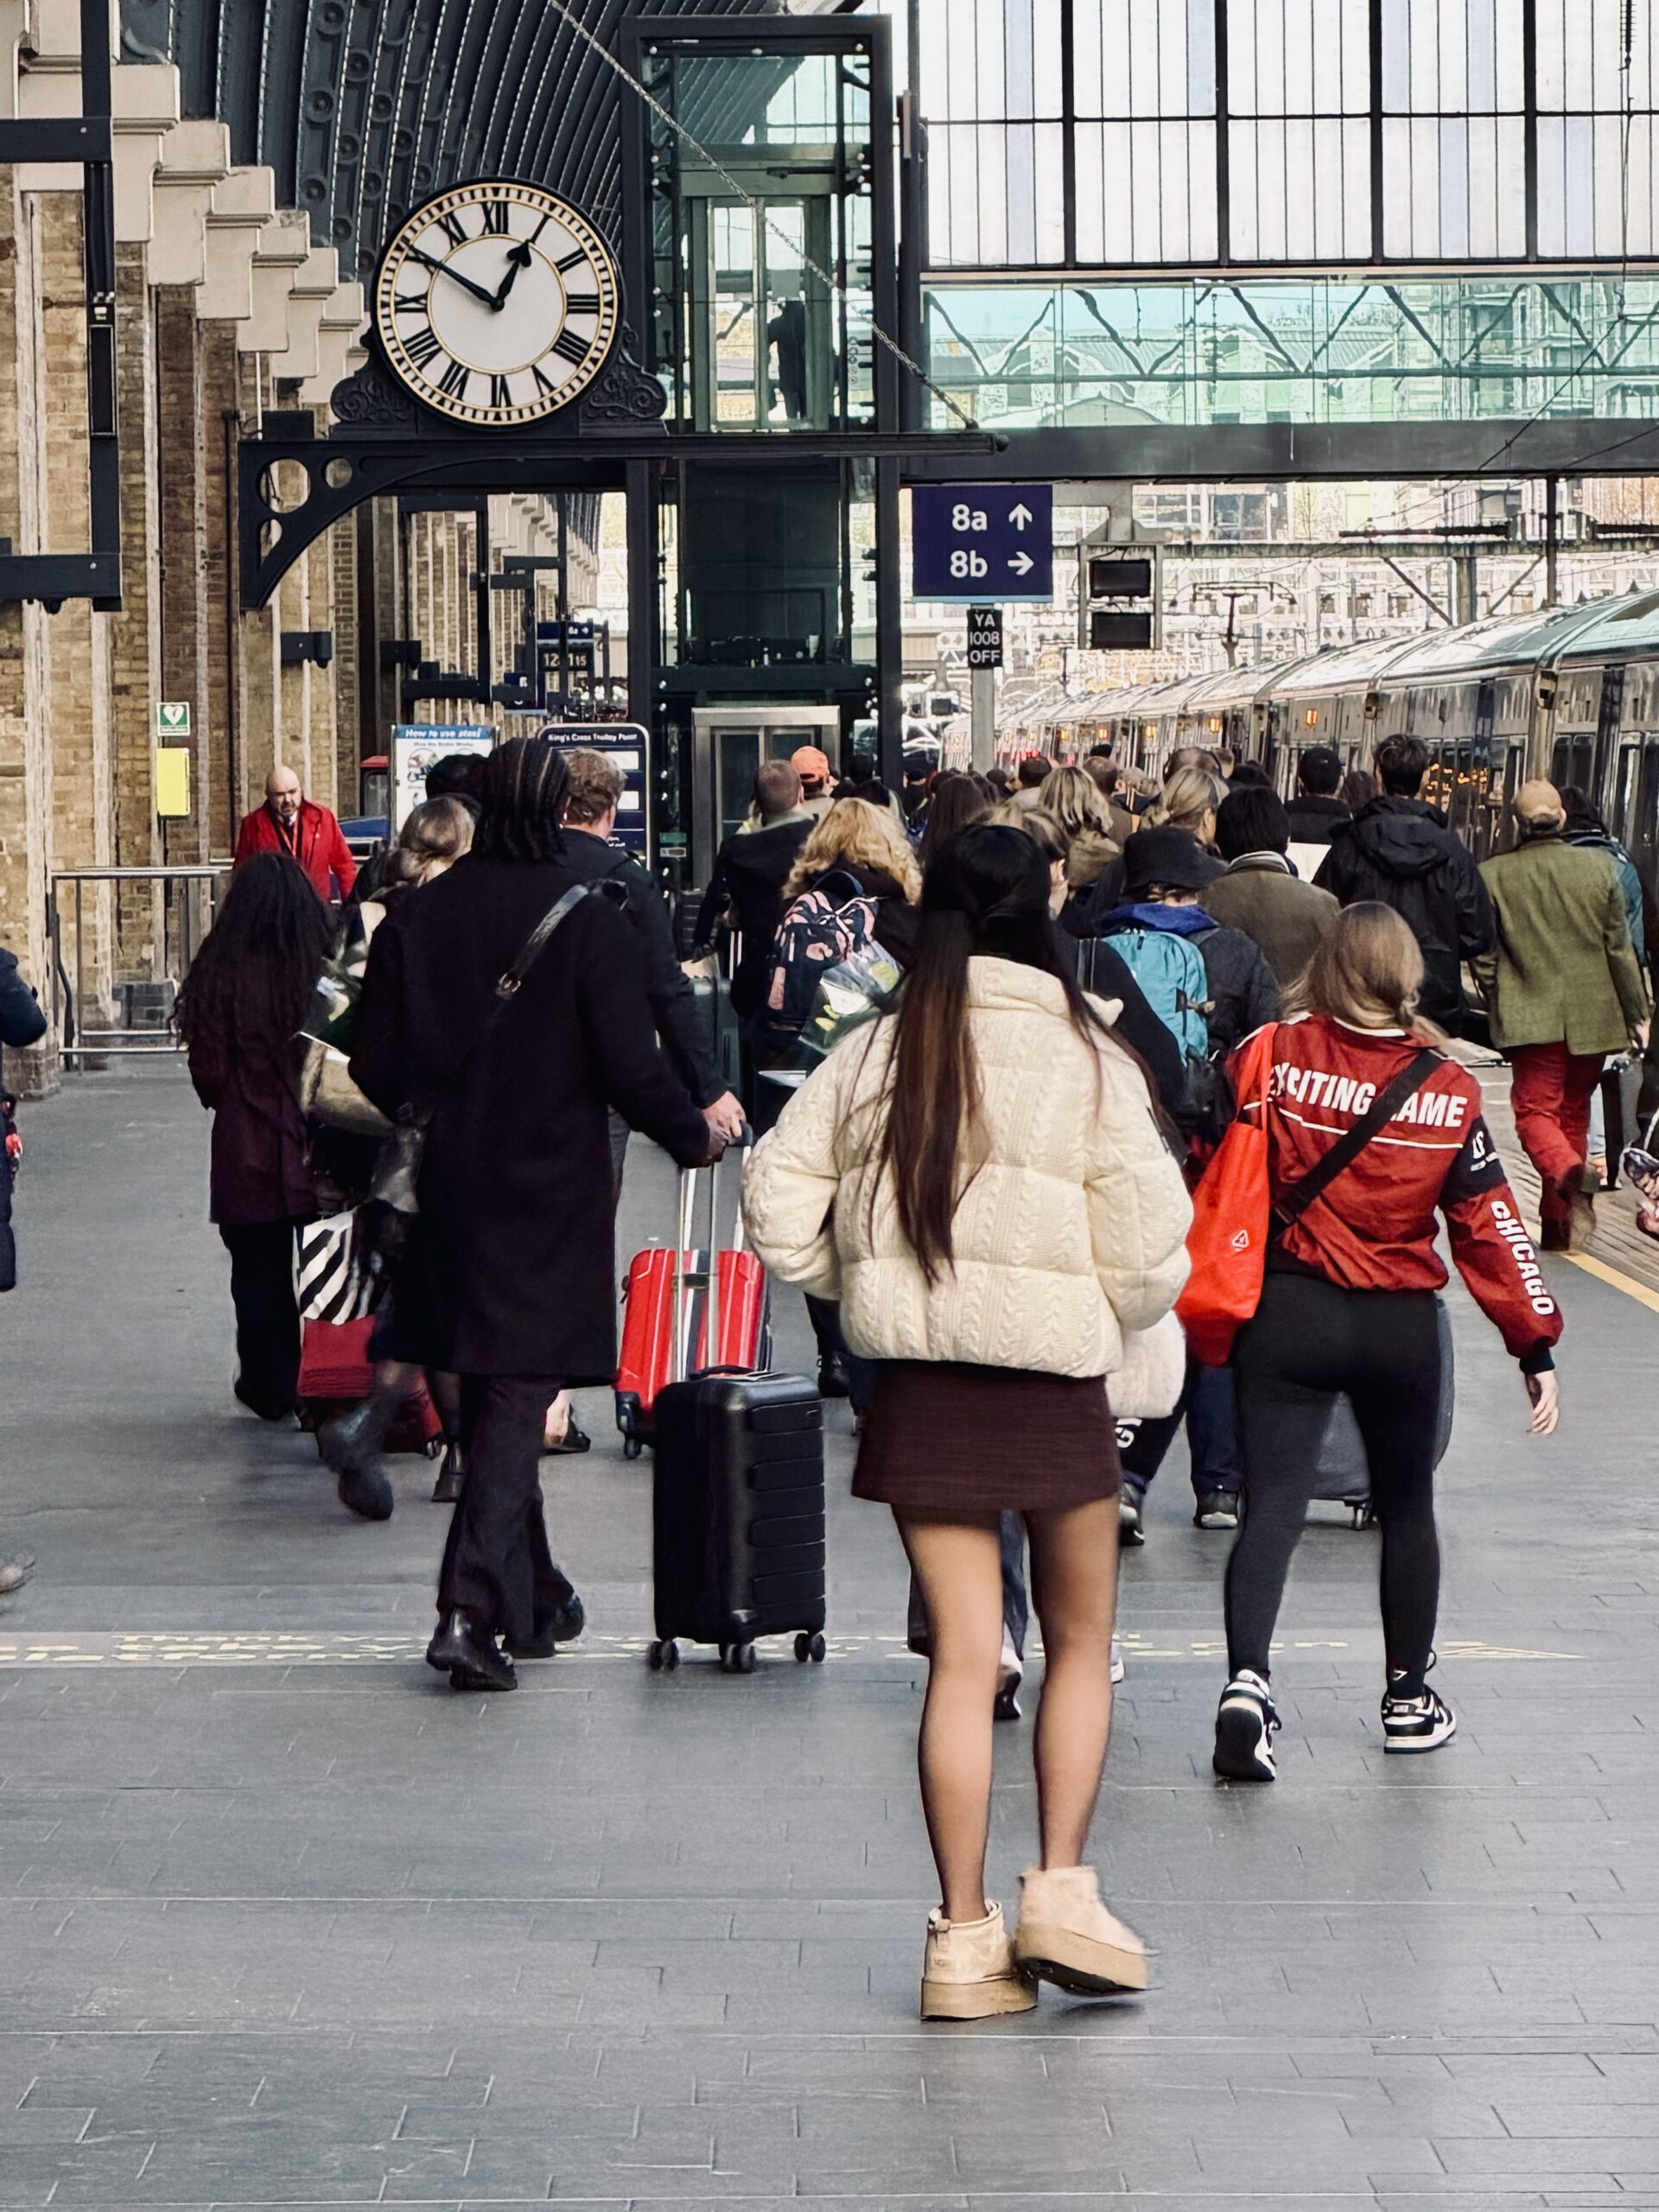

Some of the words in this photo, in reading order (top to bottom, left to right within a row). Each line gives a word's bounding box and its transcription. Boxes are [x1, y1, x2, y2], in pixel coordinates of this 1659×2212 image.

[434, 211, 469, 250] XI
[480, 200, 510, 234] XII
[529, 213, 552, 244] I
[554, 246, 589, 275] II
[394, 292, 429, 314] IX
[566, 292, 600, 315] III
[402, 327, 443, 372] VIII
[550, 328, 593, 368] IIII
[435, 359, 471, 400] VII
[490, 373, 513, 408] VI
[531, 364, 557, 397] V
[952, 504, 988, 531] 8a
[950, 550, 988, 578] 8b
[975, 613, 995, 627] YA
[969, 631, 1001, 645] 1008
[969, 650, 1001, 664] OFF
[405, 728, 427, 738] How
[429, 729, 439, 738] to
[1390, 1092, 1468, 1128] AME
[1491, 1200, 1554, 1315] CHICAGO
[0, 1652, 425, 1662] latform
